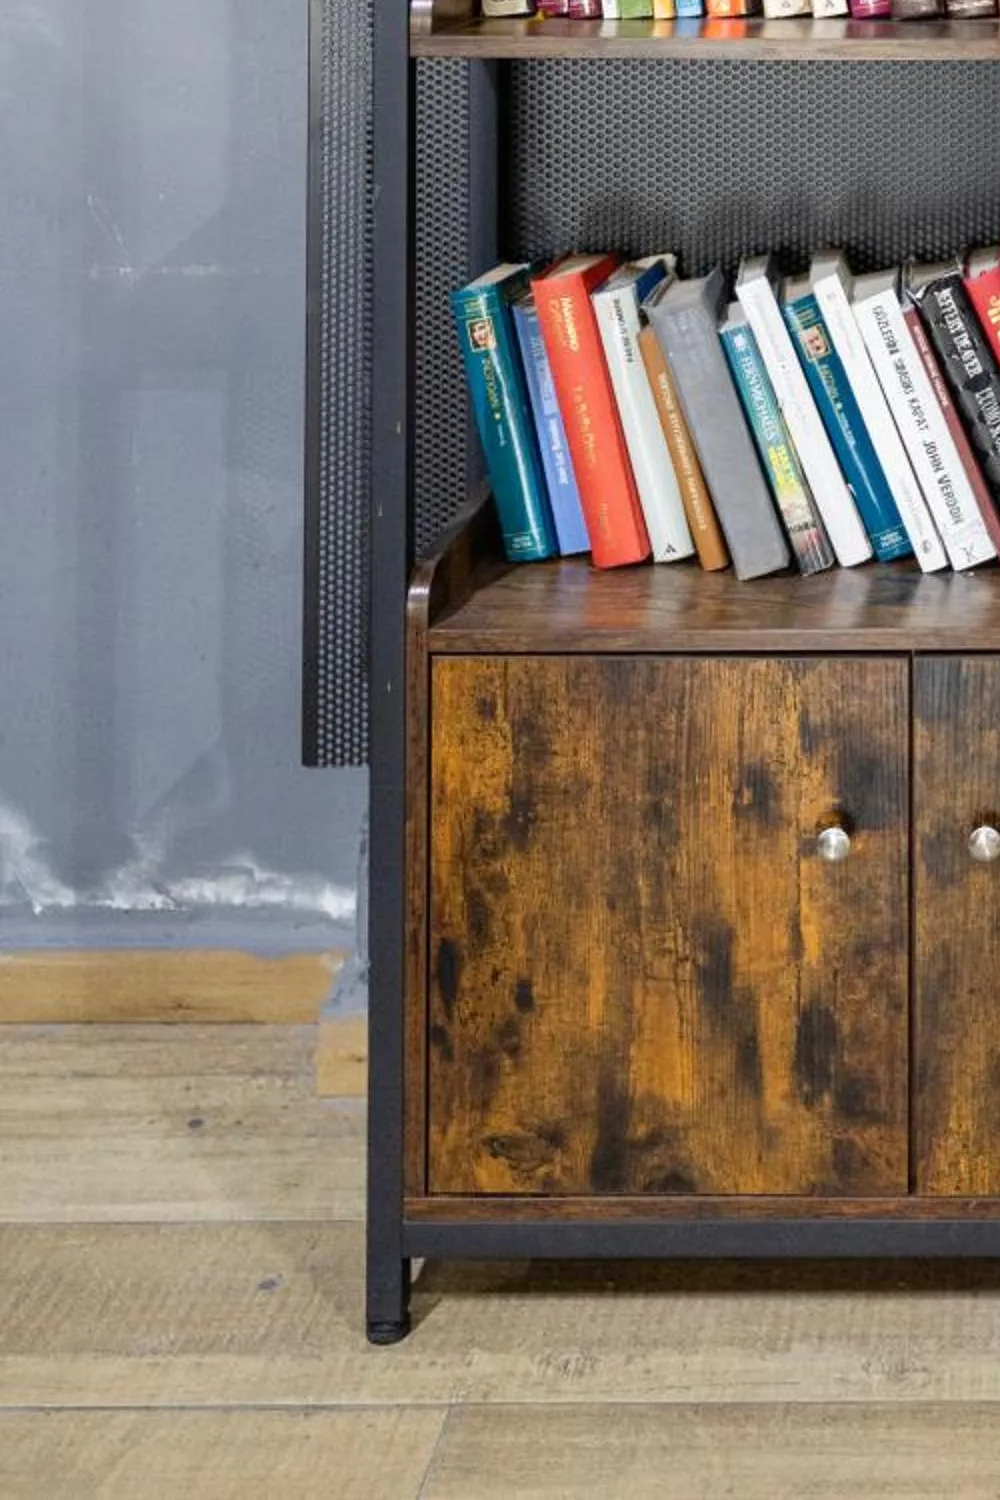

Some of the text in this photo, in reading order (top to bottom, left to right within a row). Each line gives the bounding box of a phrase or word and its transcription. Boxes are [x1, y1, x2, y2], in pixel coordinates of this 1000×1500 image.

[934, 287, 965, 334] JEFFERY
[952, 333, 983, 379] DEAVER
[922, 440, 944, 473] JOHN
[937, 474, 964, 524] VERDON
